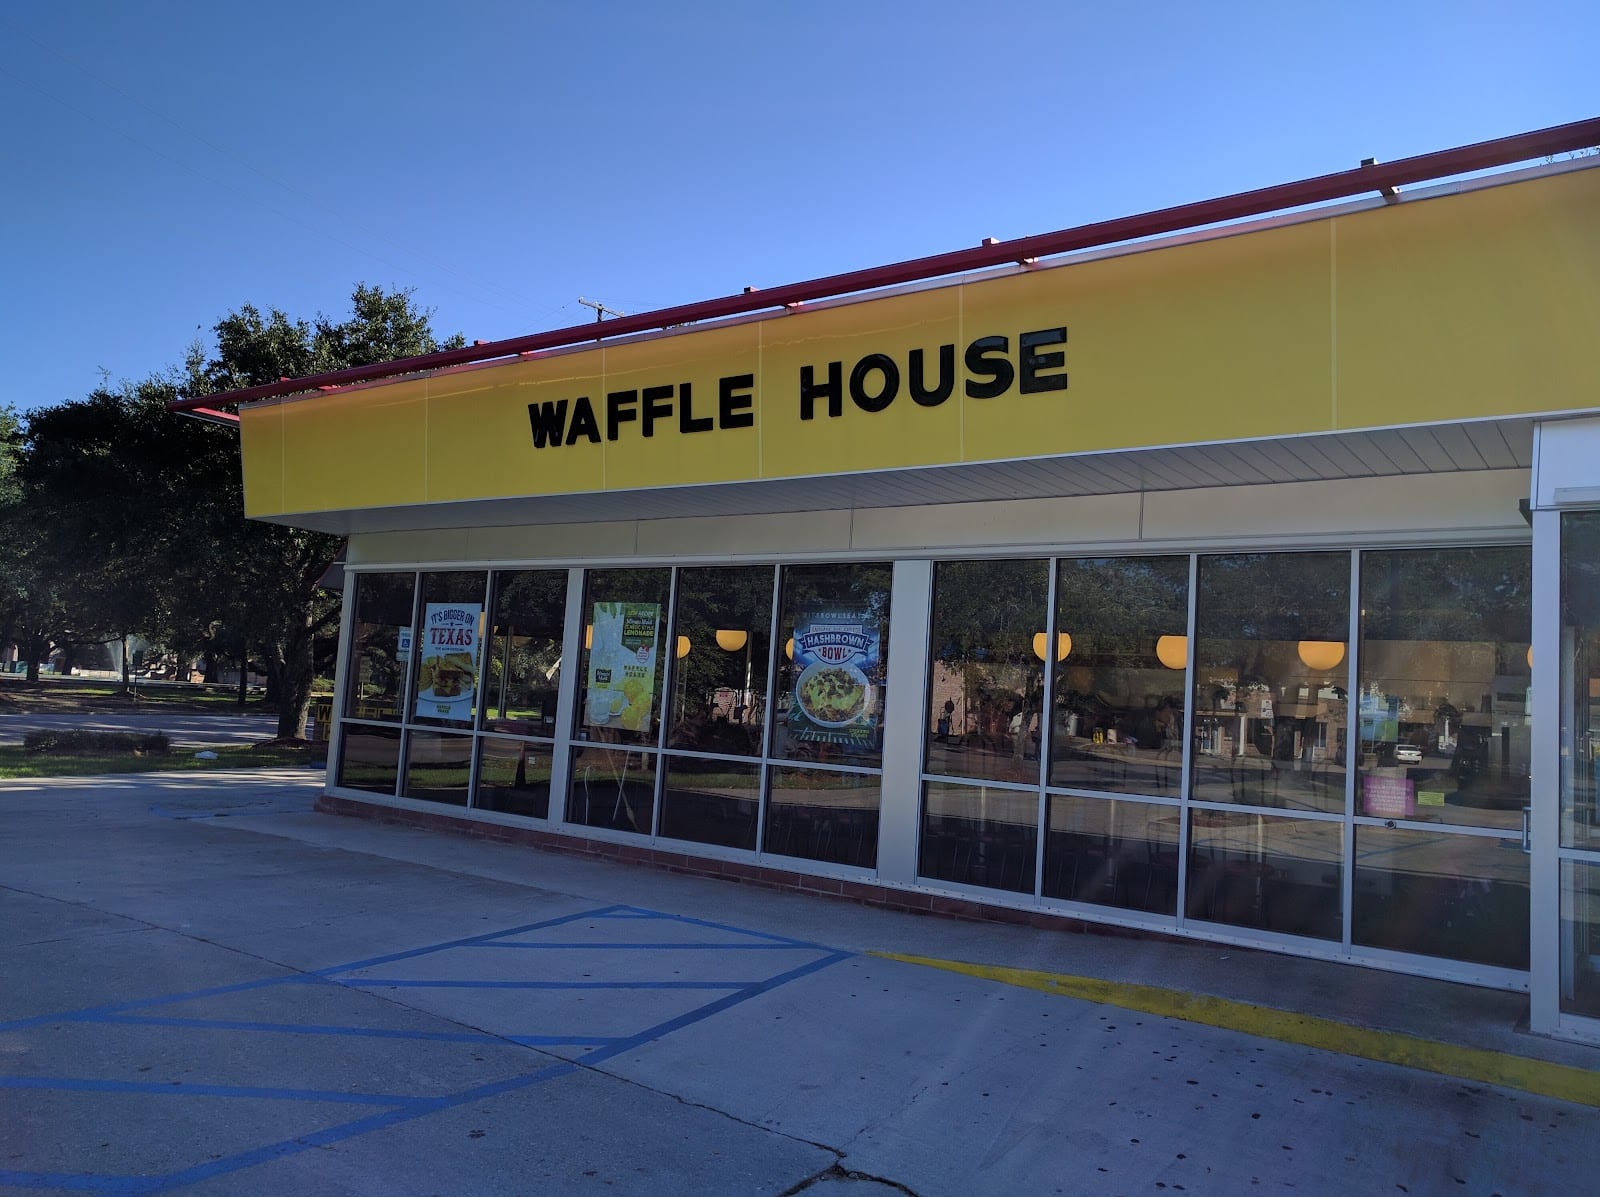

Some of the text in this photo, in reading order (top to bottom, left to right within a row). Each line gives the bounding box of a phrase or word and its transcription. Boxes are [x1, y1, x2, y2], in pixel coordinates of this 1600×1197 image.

[528, 326, 1068, 449] WAFFLE HOUSE
[431, 609, 475, 626] IT'S BIGGER ON
[430, 627, 473, 646] TEXAS
[807, 632, 865, 648] HASHBROWN
[821, 646, 848, 661] BOWL
